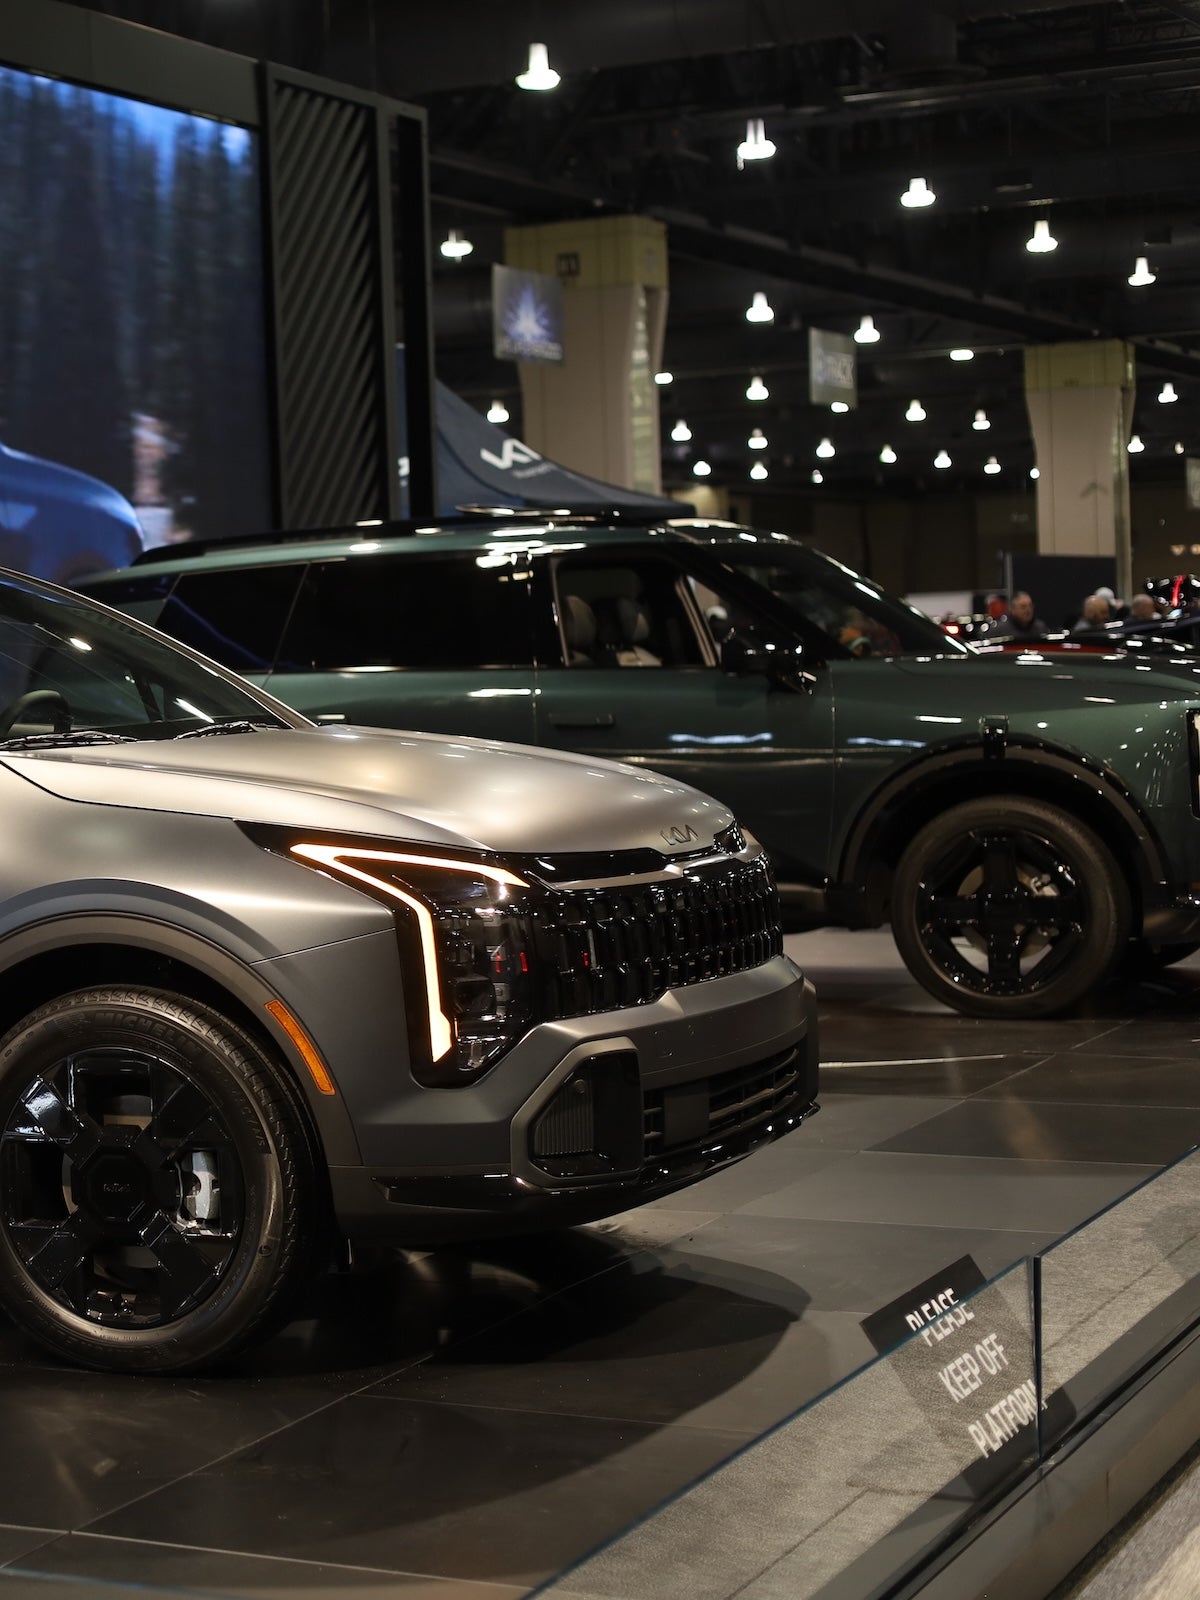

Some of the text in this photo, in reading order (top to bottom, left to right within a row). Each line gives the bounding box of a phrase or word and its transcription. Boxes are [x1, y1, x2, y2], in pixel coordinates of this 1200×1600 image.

[94, 1011, 204, 1057] MICHELIN
[904, 1287, 975, 1347] PLEASE
[938, 1333, 1009, 1403] KEEP OFF
